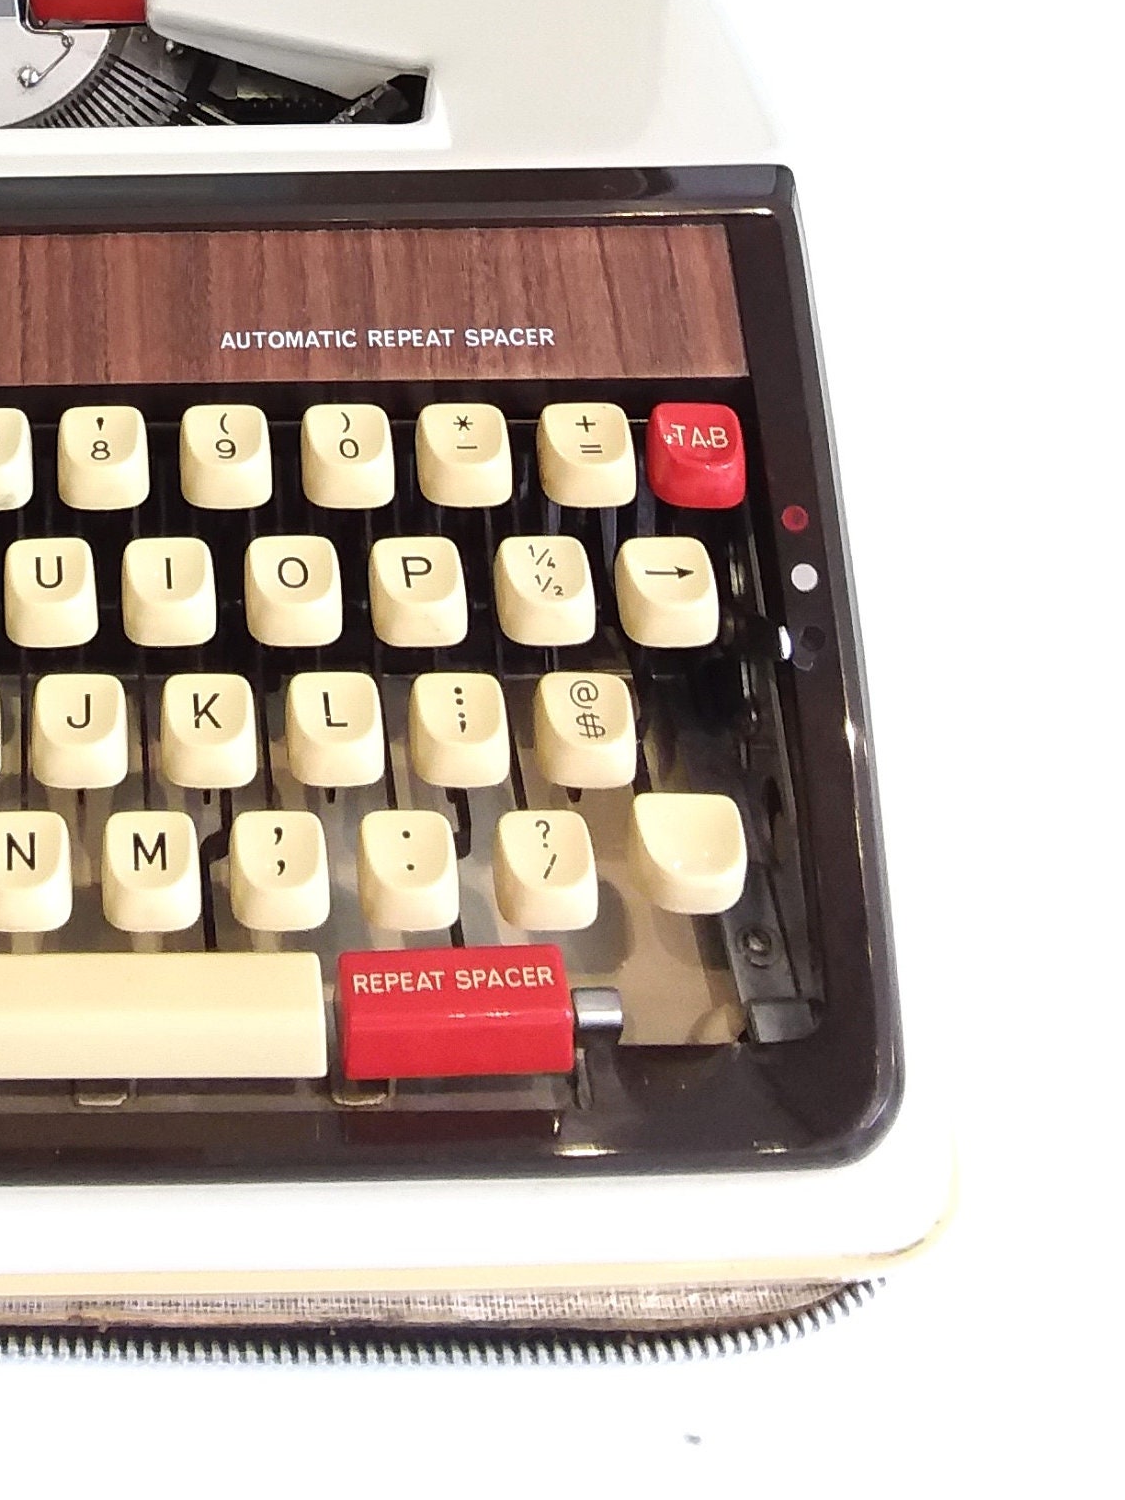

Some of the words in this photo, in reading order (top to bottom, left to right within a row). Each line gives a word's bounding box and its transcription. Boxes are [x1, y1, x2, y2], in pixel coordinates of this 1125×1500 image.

[221, 329, 357, 349] AUTOMATIC
[368, 329, 455, 347] REPEAT
[465, 328, 555, 347] SPACER
[220, 413, 229, 434] (
[341, 412, 350, 433] )
[576, 416, 596, 432] +
[672, 424, 729, 449] TAB
[91, 440, 110, 460] 8
[216, 439, 236, 459] 9
[580, 444, 602, 453] =
[36, 556, 63, 588] U
[165, 558, 172, 589] I
[278, 557, 308, 588] O
[402, 556, 432, 588] P
[570, 680, 598, 709] @
[67, 694, 90, 729] J
[193, 693, 221, 728] K
[323, 692, 348, 727] L
[576, 713, 606, 738] $
[536, 820, 550, 848] ?
[7, 832, 35, 871] N
[133, 832, 166, 871] M
[353, 971, 446, 995] REPEAT
[453, 964, 555, 990] SPACER
